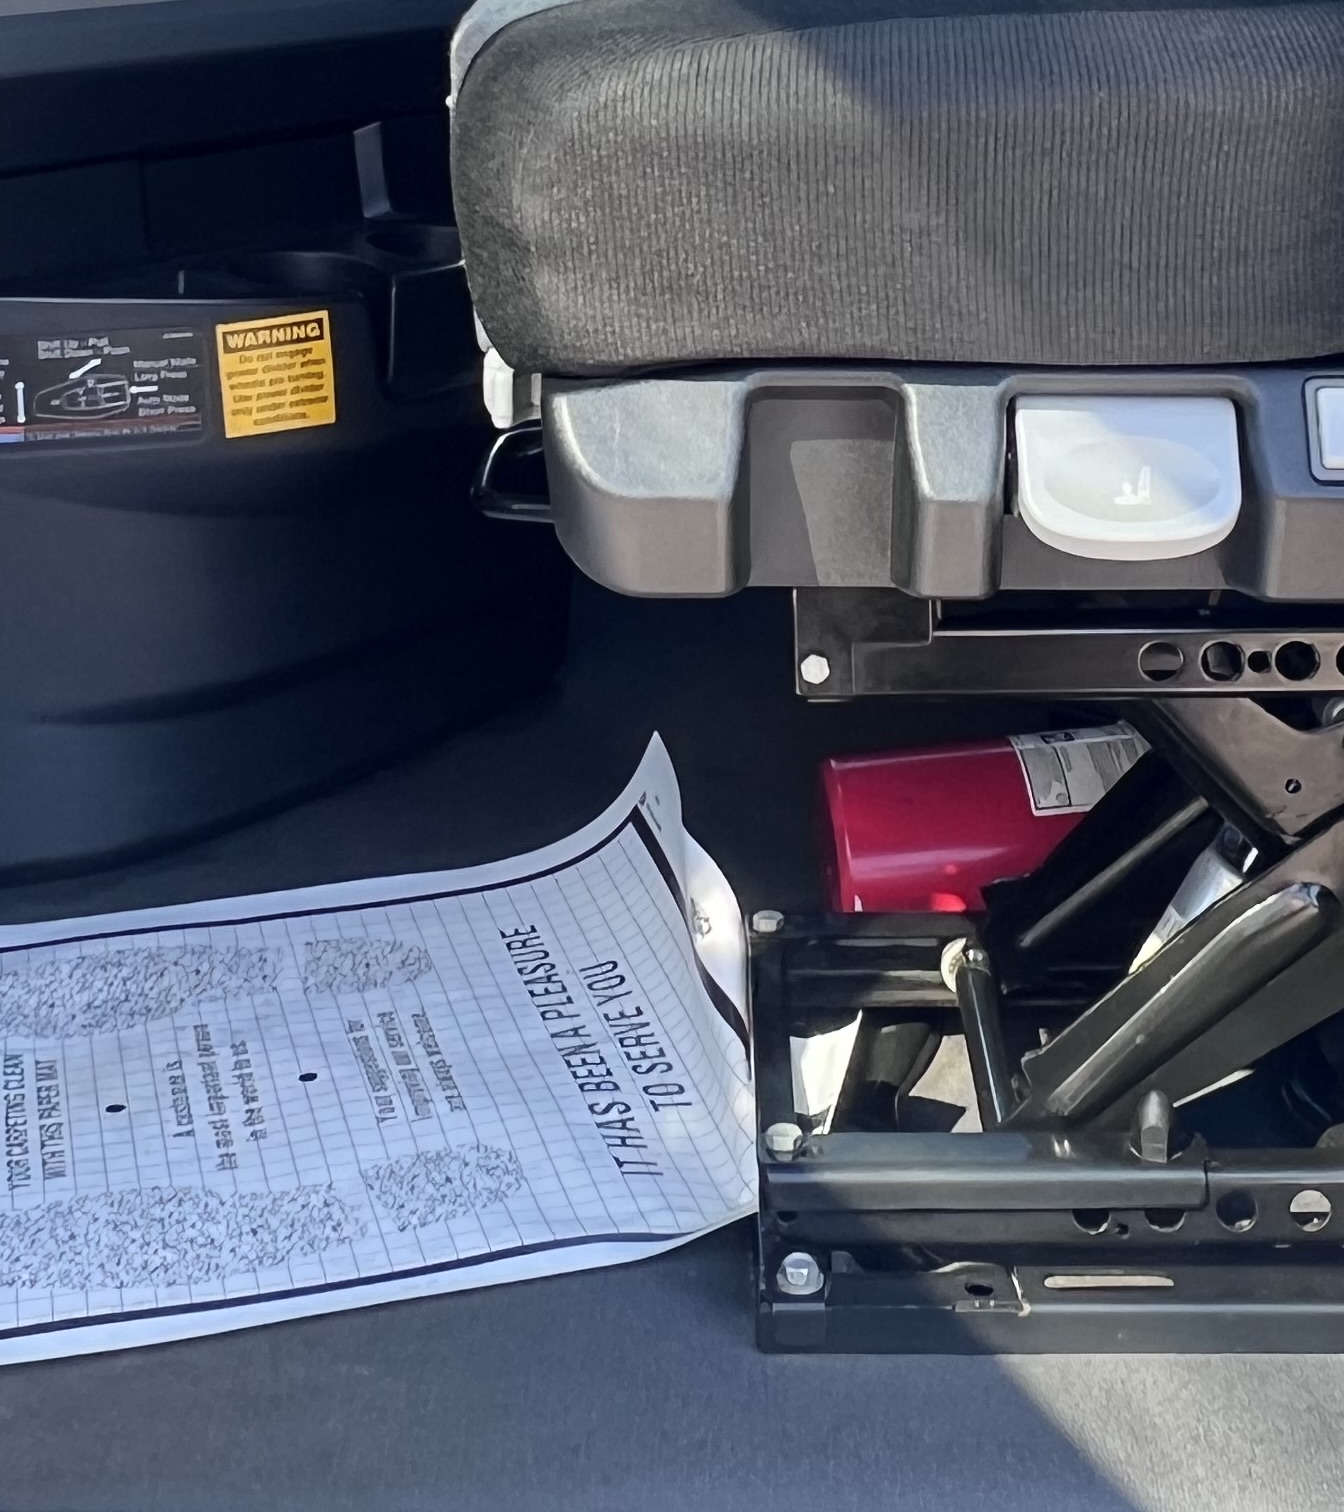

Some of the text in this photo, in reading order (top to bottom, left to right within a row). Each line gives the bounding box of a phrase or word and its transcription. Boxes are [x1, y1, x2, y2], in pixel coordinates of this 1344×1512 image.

[226, 322, 321, 348] WARNING
[499, 924, 664, 1177] IT HAS BEEN A PLEASURE
[579, 960, 693, 1113] TO SERVE YOU
